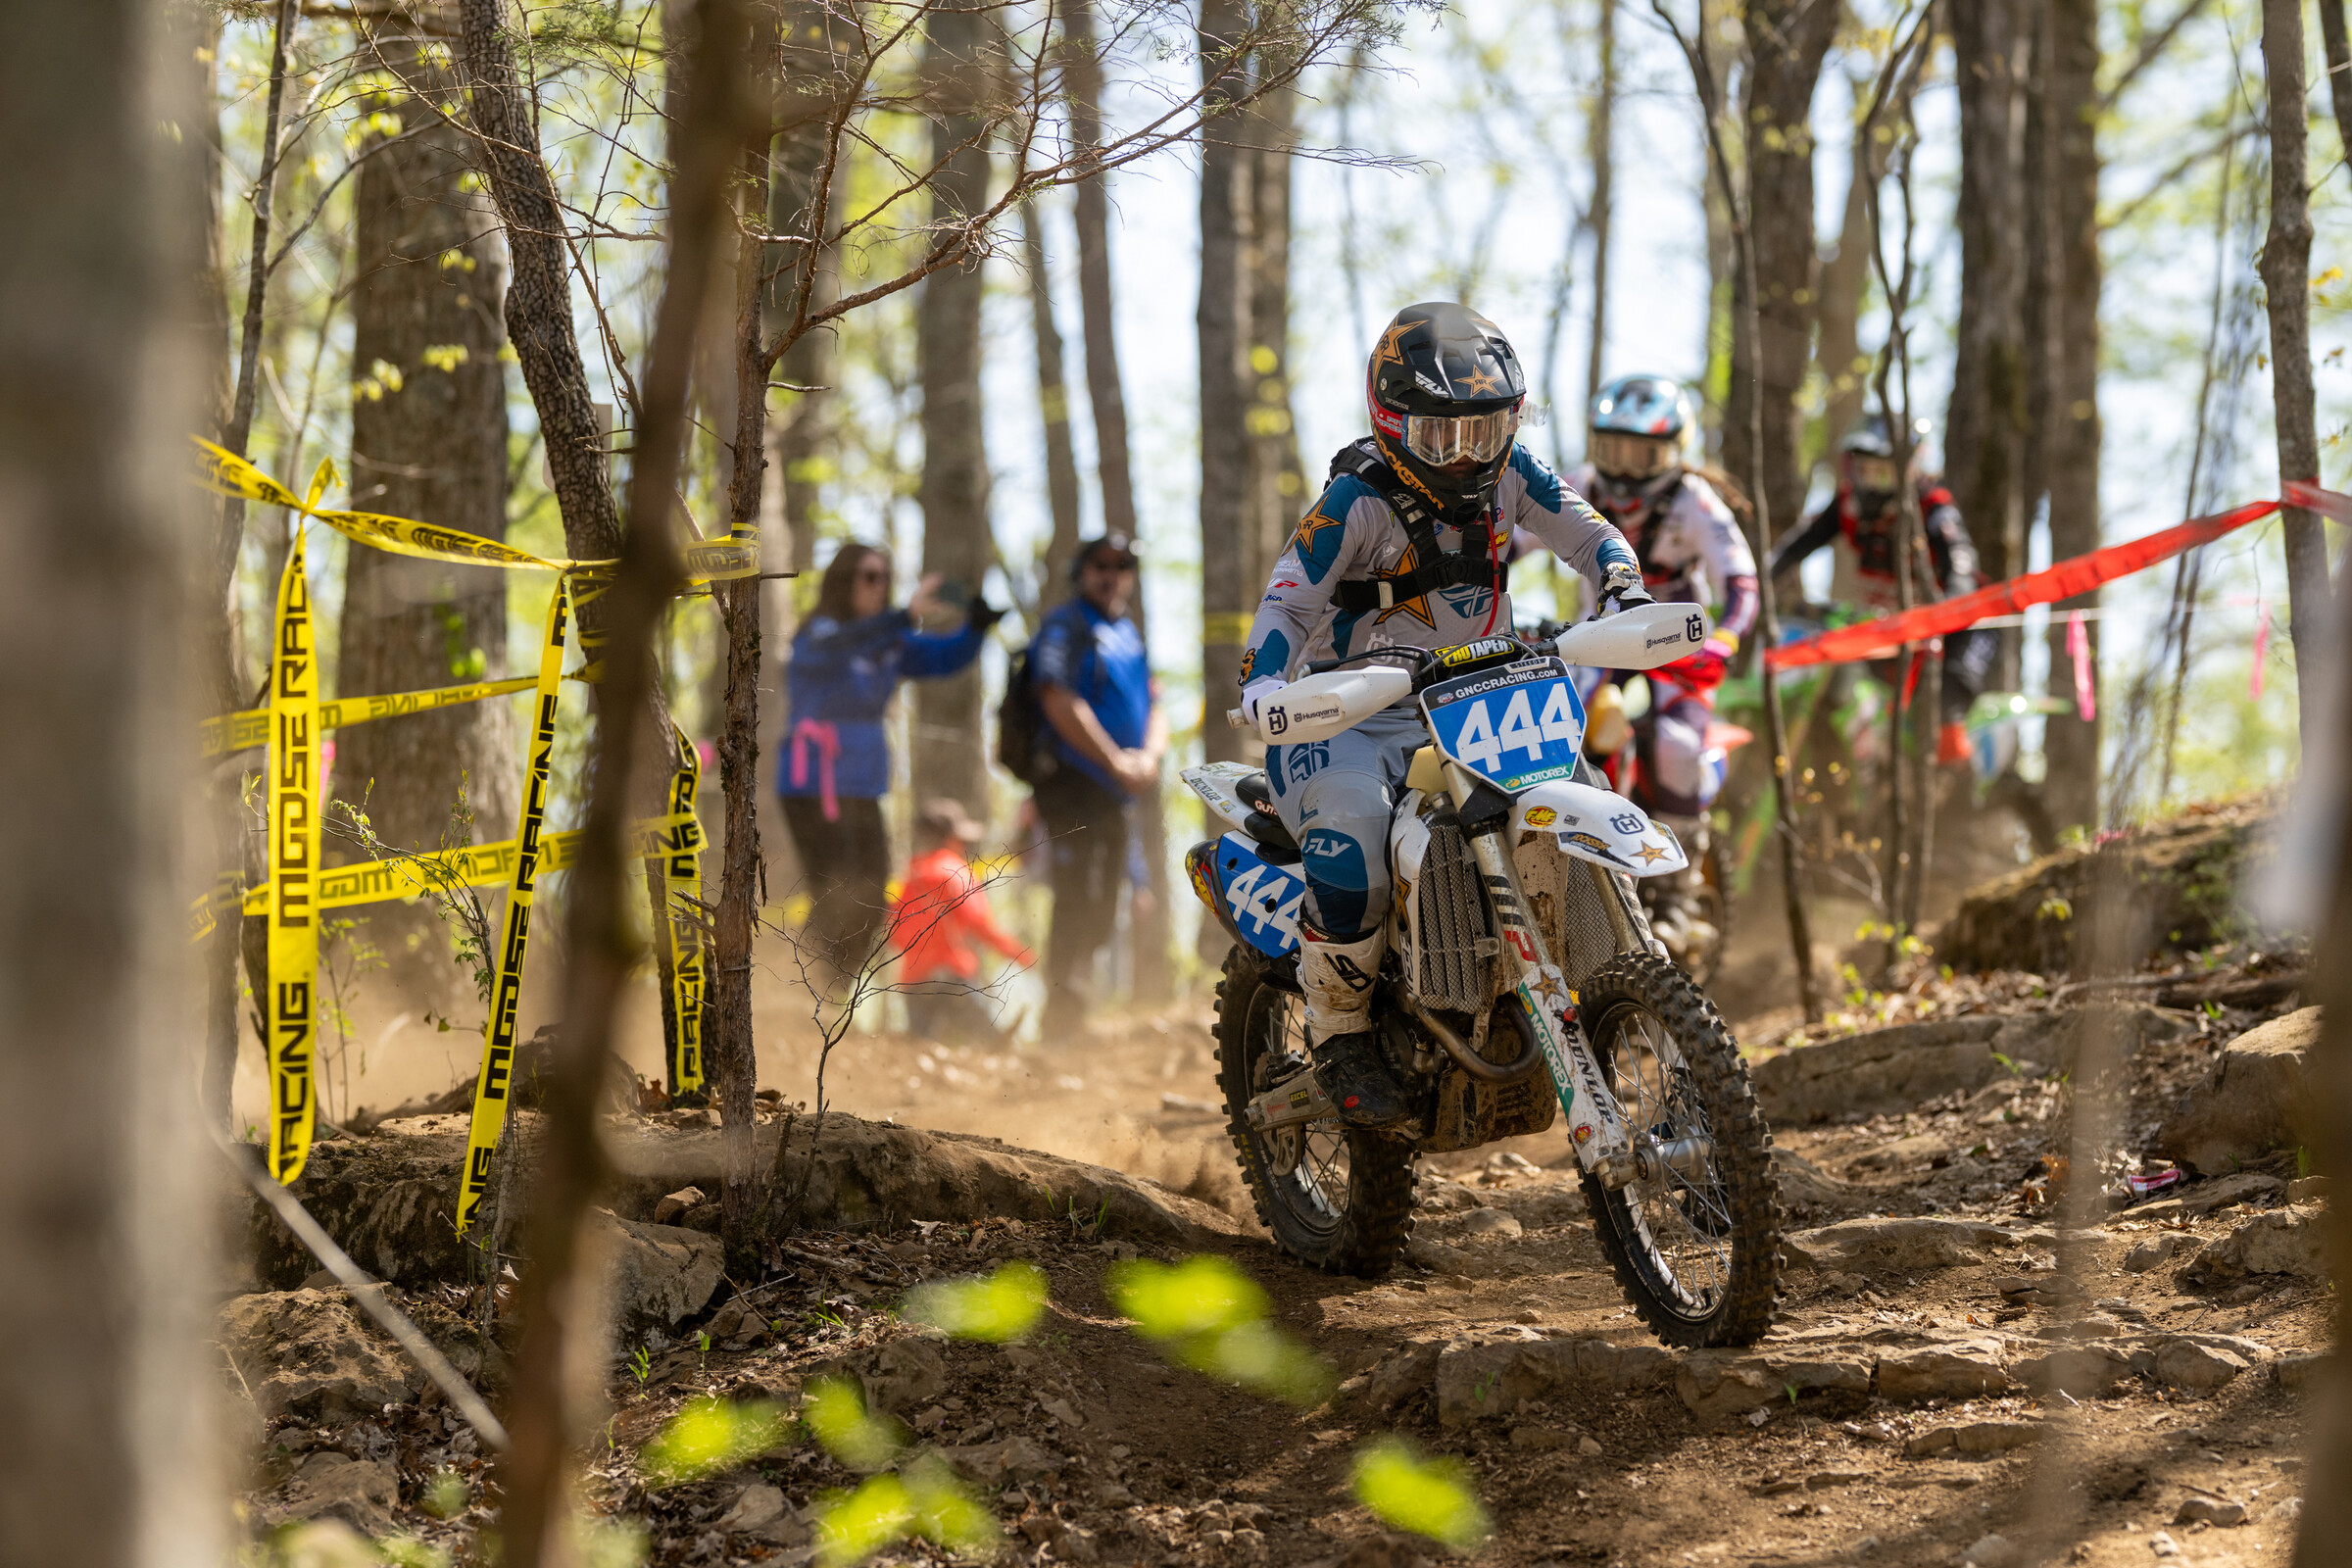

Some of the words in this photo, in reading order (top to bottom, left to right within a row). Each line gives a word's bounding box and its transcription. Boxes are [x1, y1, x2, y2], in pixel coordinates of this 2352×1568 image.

[1651, 632, 1682, 646] Husqvarna
[1455, 668, 1559, 700] GNCCRACING.COM
[1302, 708, 1340, 720] Husqvarna
[1456, 682, 1583, 774] 444
[1190, 777, 1222, 802] DUNLOP
[1519, 766, 1570, 786] MOTOREX
[279, 712, 309, 927] MOOSE
[1525, 808, 1558, 822] FMF
[1304, 837, 1352, 858] FLY
[1226, 863, 1305, 951] 444
[484, 900, 532, 1100] MOOSE
[1531, 1013, 1573, 1095] MOTOREX
[1566, 1032, 1615, 1125] DUNLOP
[1290, 1090, 1308, 1102] EXCEL
